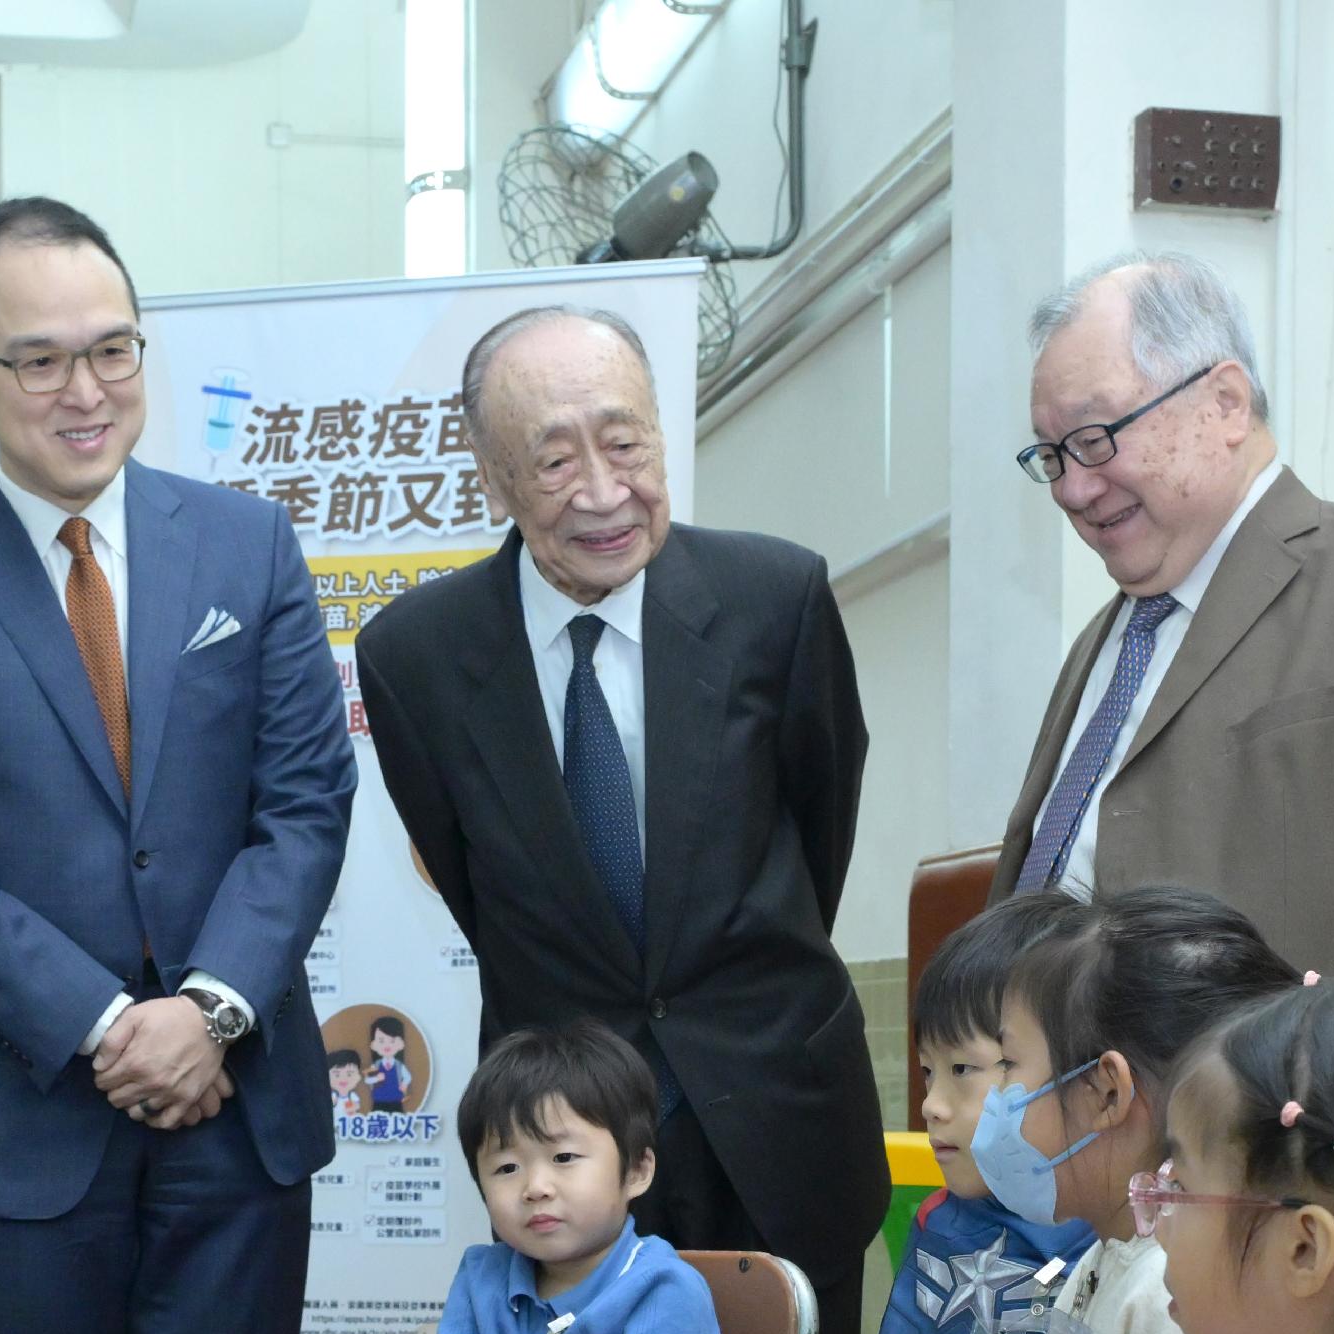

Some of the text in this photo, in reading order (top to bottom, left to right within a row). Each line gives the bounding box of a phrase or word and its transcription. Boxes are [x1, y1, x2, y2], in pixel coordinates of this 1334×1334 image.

[216, 470, 509, 534] 季節又到
[338, 1115, 439, 1139] 18歲以下
